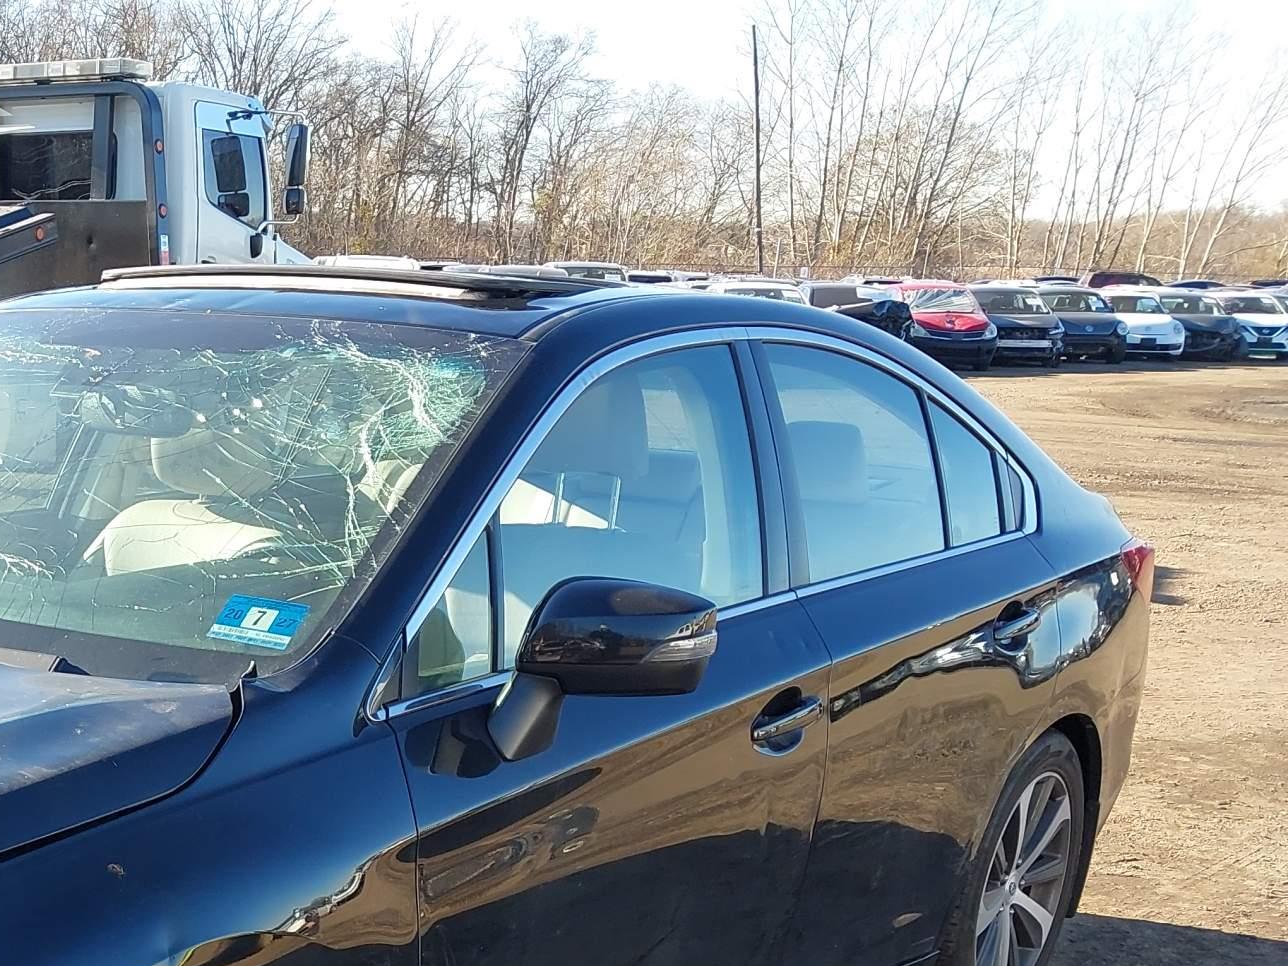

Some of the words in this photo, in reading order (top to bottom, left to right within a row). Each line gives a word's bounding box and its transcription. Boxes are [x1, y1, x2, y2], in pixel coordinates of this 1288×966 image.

[223, 608, 244, 620] 20
[252, 610, 267, 626] 7
[275, 617, 299, 629] 27
